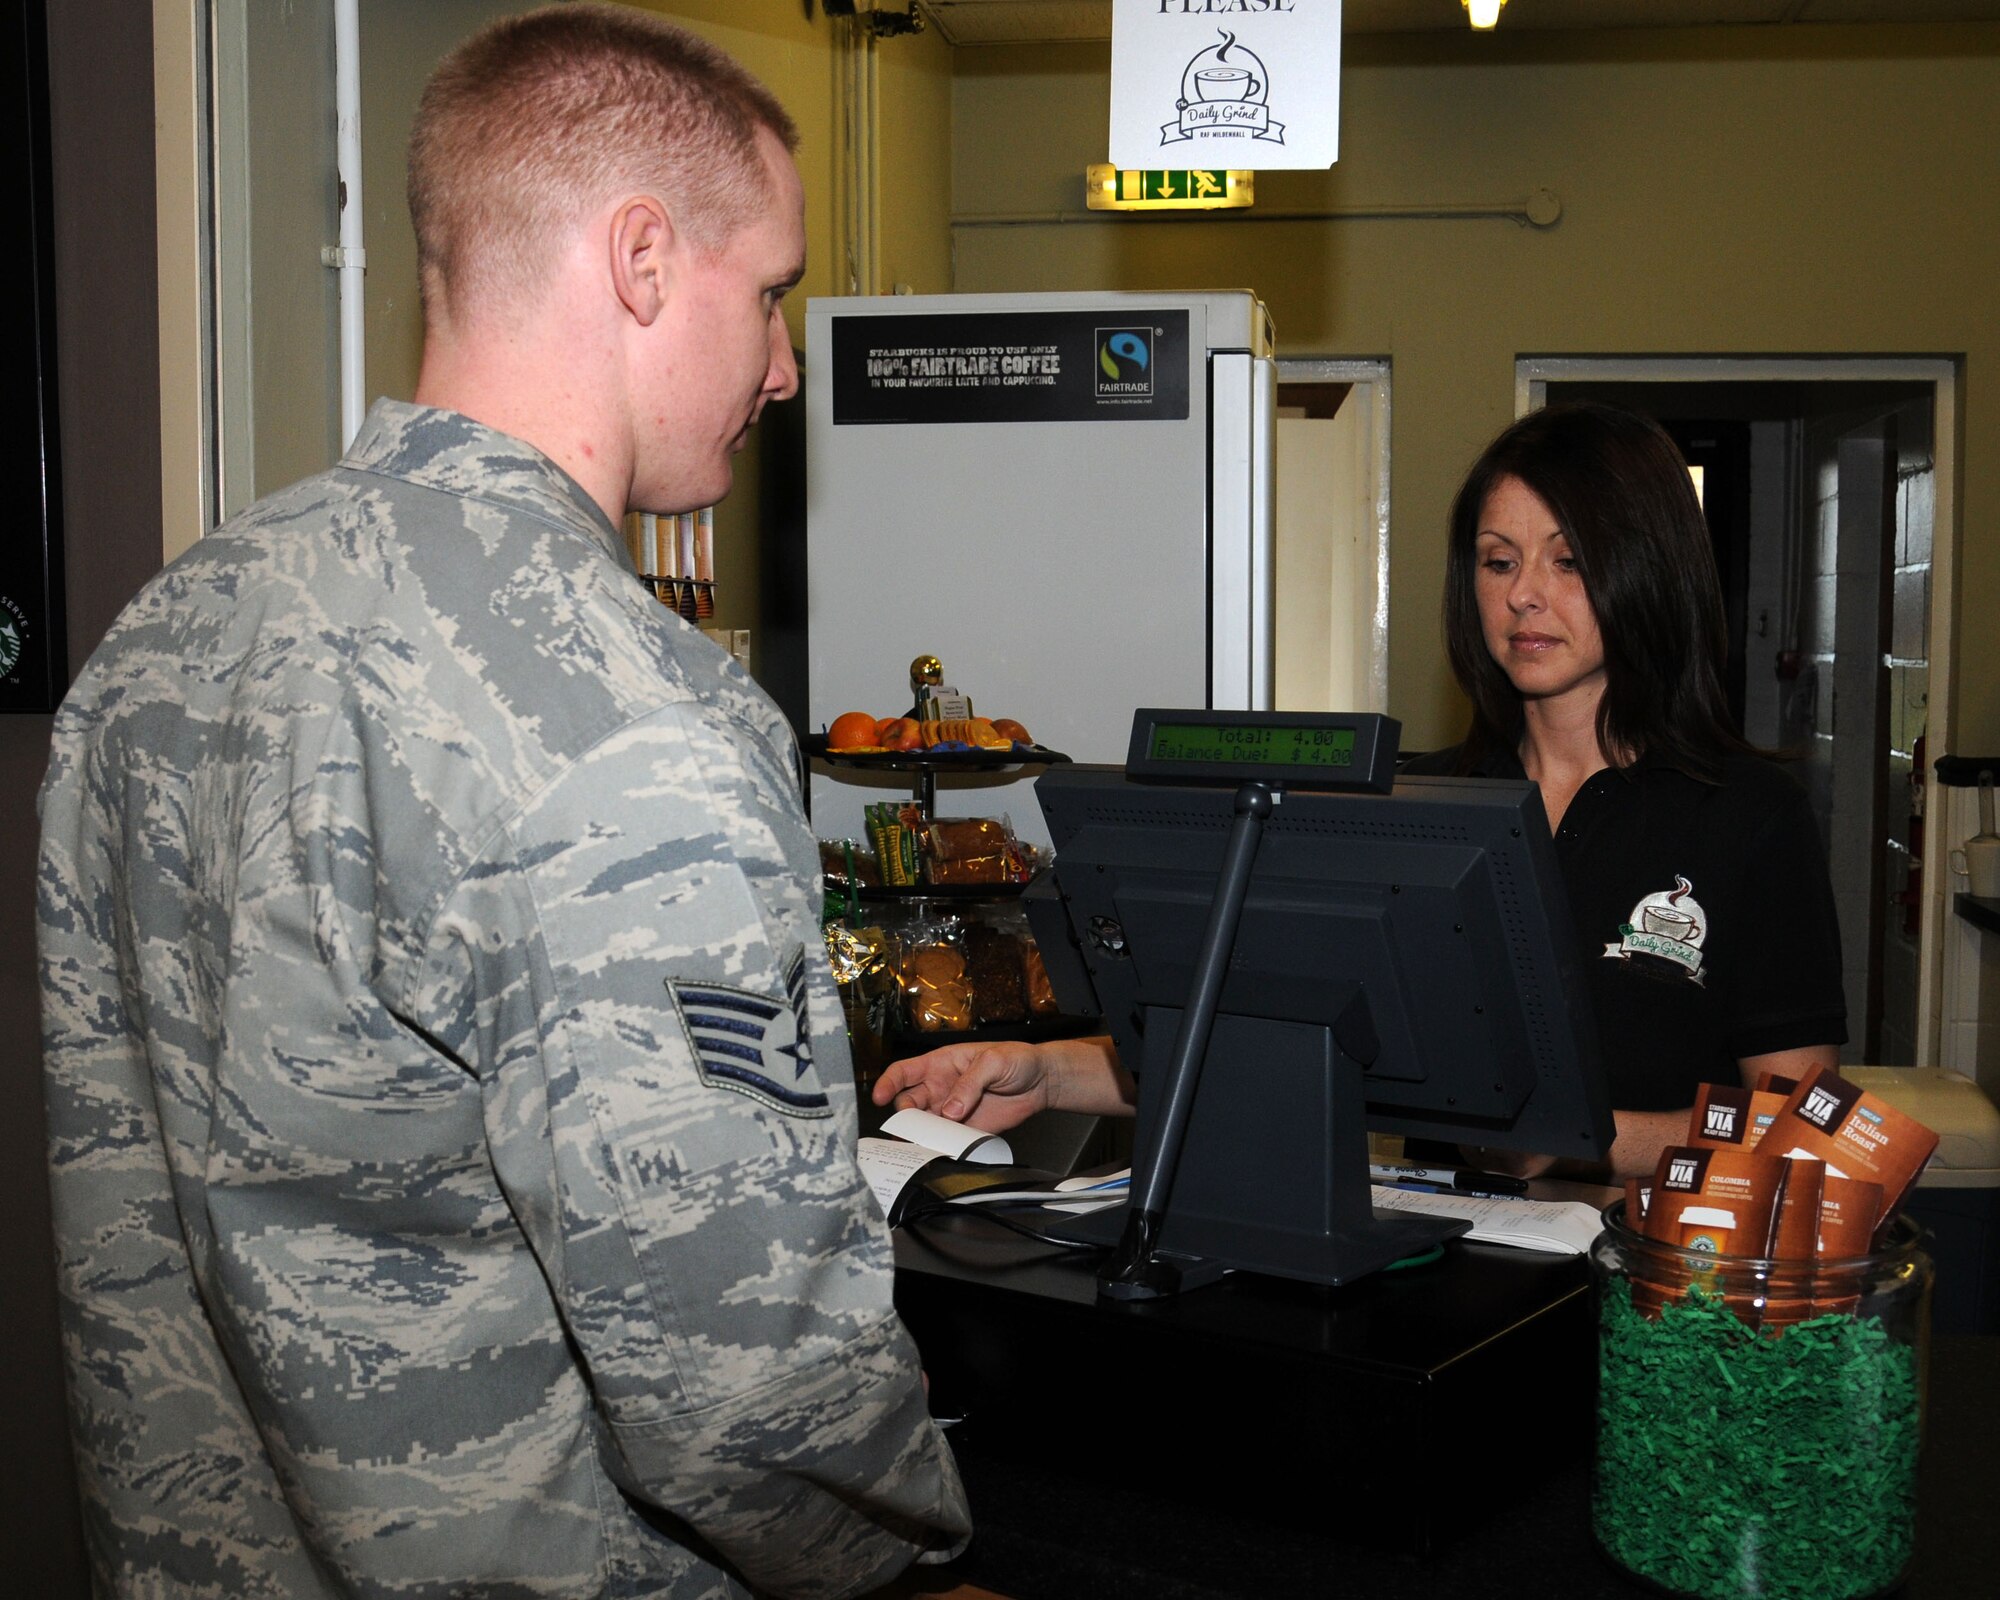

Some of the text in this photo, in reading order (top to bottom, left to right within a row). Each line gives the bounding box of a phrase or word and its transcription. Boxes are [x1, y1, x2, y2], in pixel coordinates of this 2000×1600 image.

[1187, 105, 1259, 123] Daily Grind
[869, 345, 1058, 357] STARBUCKS IS PROUD TO USE ONLY
[867, 355, 1060, 377] 100% FAIRTRADE COFFEE
[871, 378, 880, 388] IN
[883, 378, 906, 388] YOUR
[909, 377, 953, 387] FAVOURITE
[955, 377, 980, 387] LATTE
[982, 376, 1000, 386] AND
[1099, 383, 1149, 392] FAIRTRADE
[1, 596, 28, 628] SERVE
[1217, 729, 1333, 746] Total: 4.00
[1157, 743, 1351, 764] Balance Due: $ 4.00
[1629, 935, 1695, 962] Daily Grind
[1805, 1092, 1836, 1121] VIA
[1707, 1110, 1734, 1132] VIA
[1849, 1115, 1889, 1146] Italian
[1841, 1125, 1878, 1153] Roast
[1669, 1164, 1694, 1183] VIA
[1709, 1175, 1751, 1186] COLOMBIA
